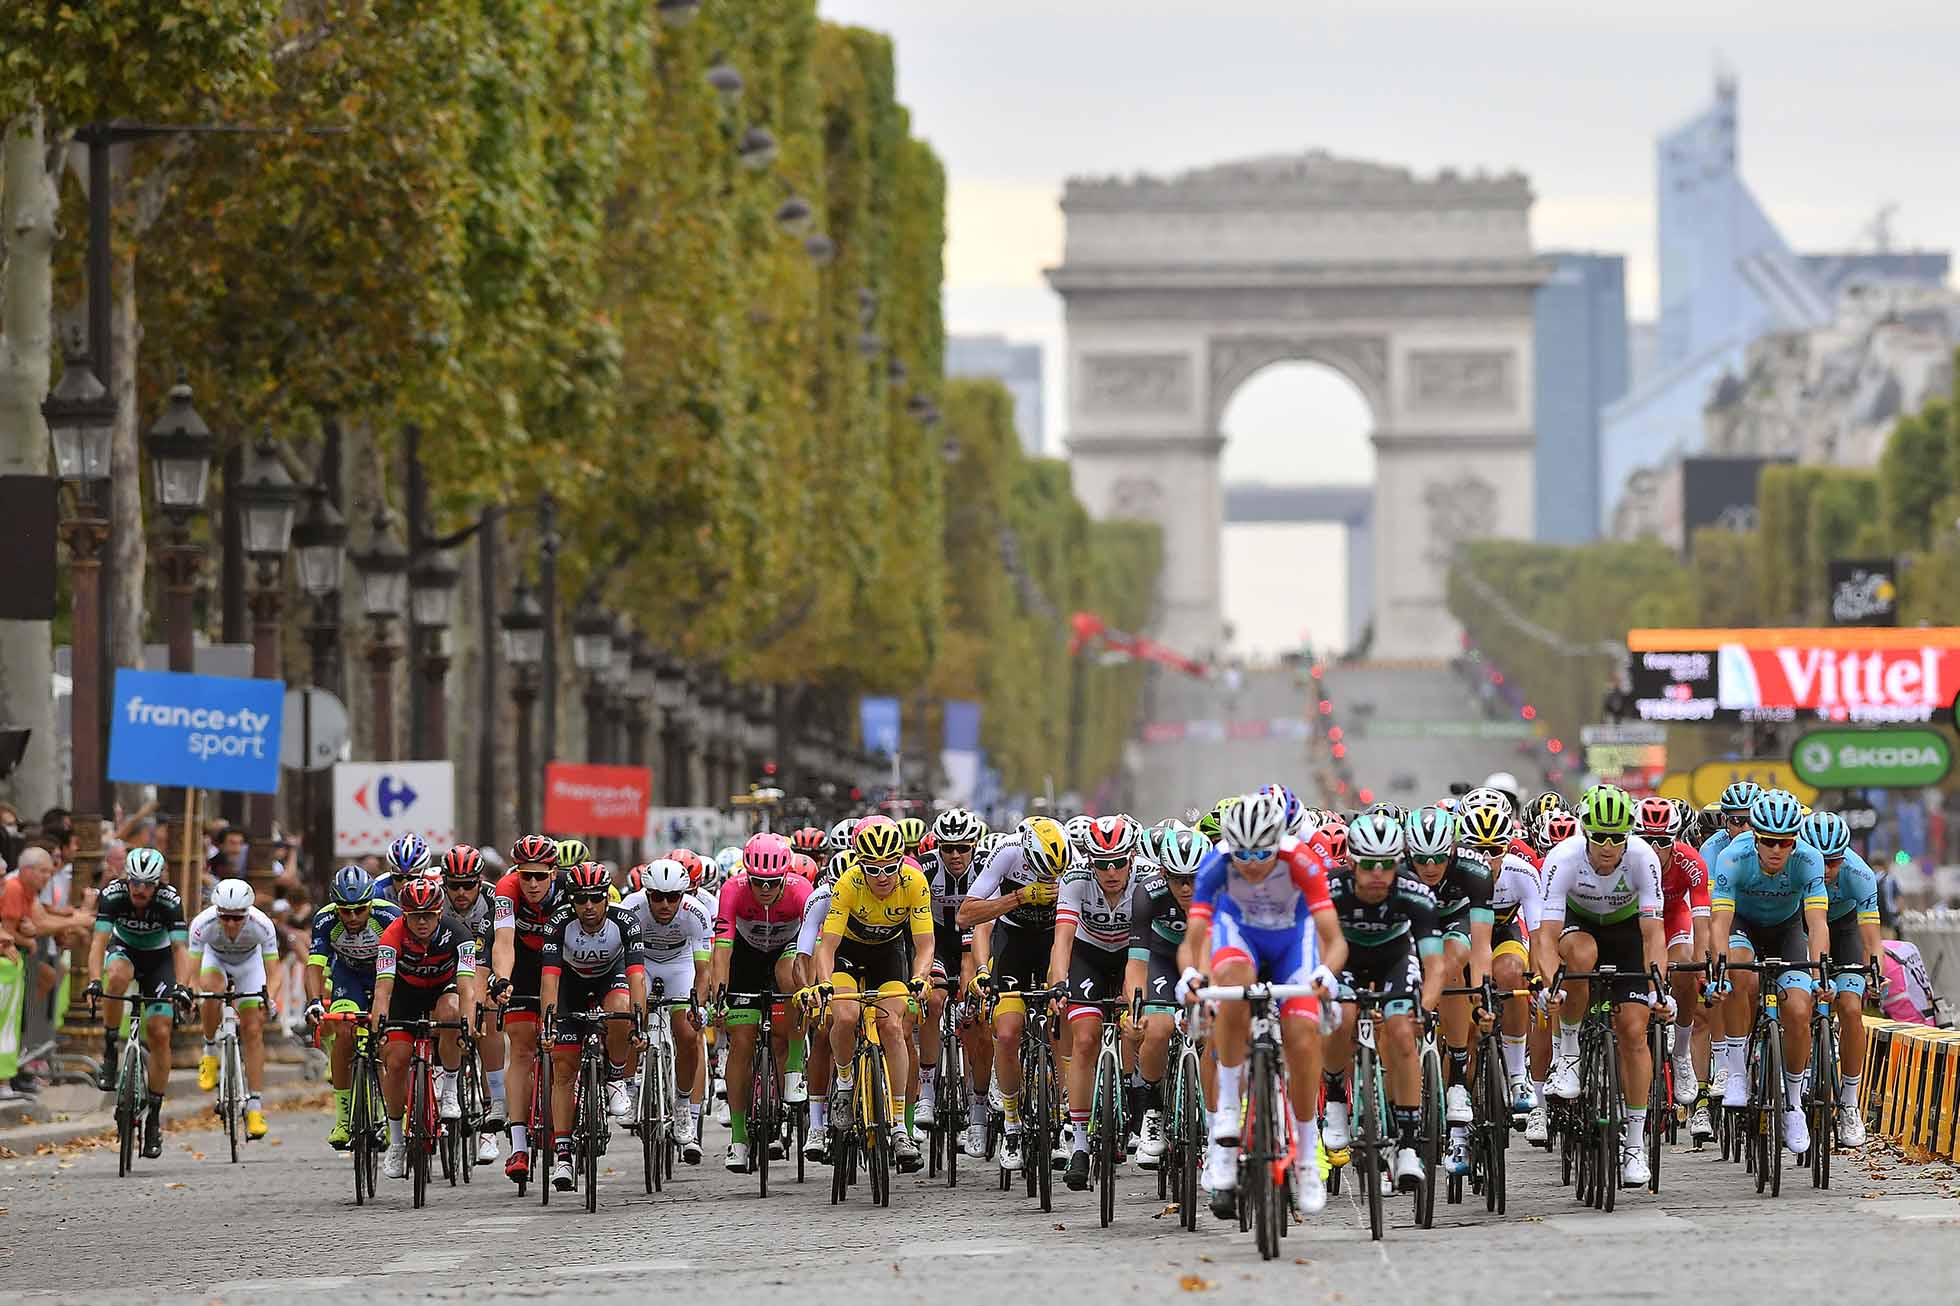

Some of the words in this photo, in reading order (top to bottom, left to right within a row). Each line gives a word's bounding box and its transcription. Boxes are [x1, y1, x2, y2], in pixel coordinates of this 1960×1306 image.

[1777, 646, 1946, 704] Vittel
[188, 732, 266, 761] sport
[1457, 848, 1491, 870] BORA
[920, 860, 938, 873] ANT
[1672, 851, 1704, 887] Cofidis
[102, 882, 128, 896] BORA
[550, 910, 569, 925] UAE
[616, 911, 634, 925] UAE
[572, 949, 610, 961] UAE
[1629, 991, 1649, 1001] Delo
